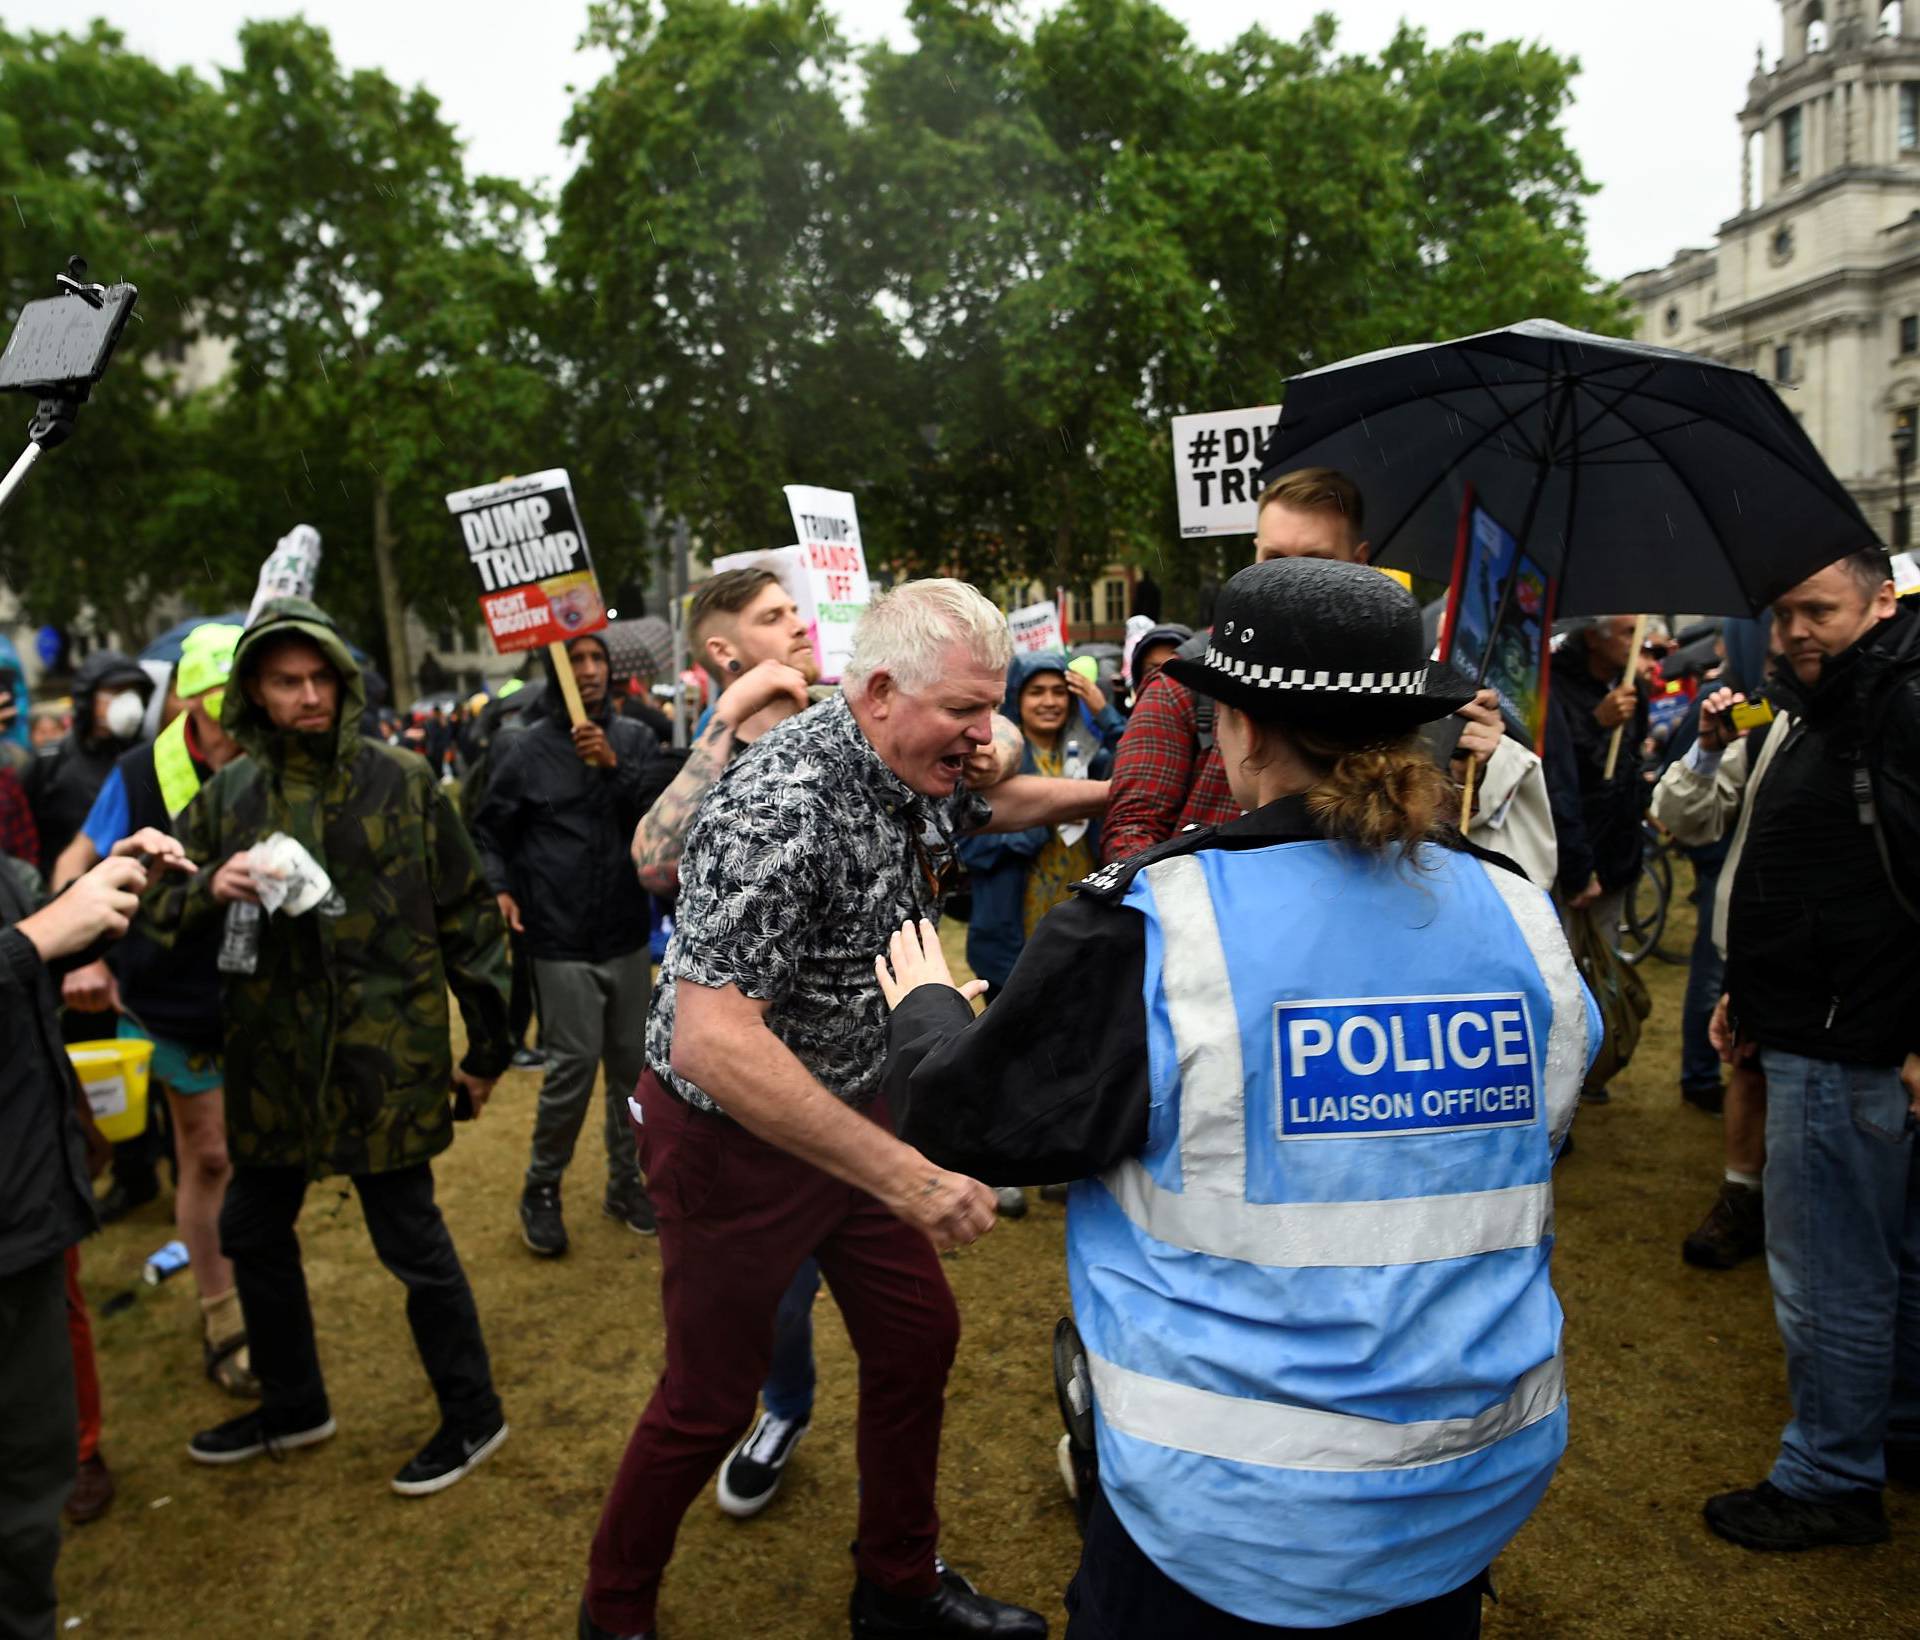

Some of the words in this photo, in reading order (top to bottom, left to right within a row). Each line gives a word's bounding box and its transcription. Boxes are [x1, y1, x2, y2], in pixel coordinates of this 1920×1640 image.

[460, 496, 551, 553] DUMP
[470, 530, 579, 592] TRUMP
[808, 543, 860, 573] HANDS
[485, 591, 528, 619] FIGHT
[826, 574, 851, 602] OFF
[491, 605, 551, 637] BIGOTRY
[1288, 1010, 1529, 1077] POLICE
[1290, 1092, 1414, 1123] LIAISON
[1422, 1084, 1531, 1117] OFFICER
